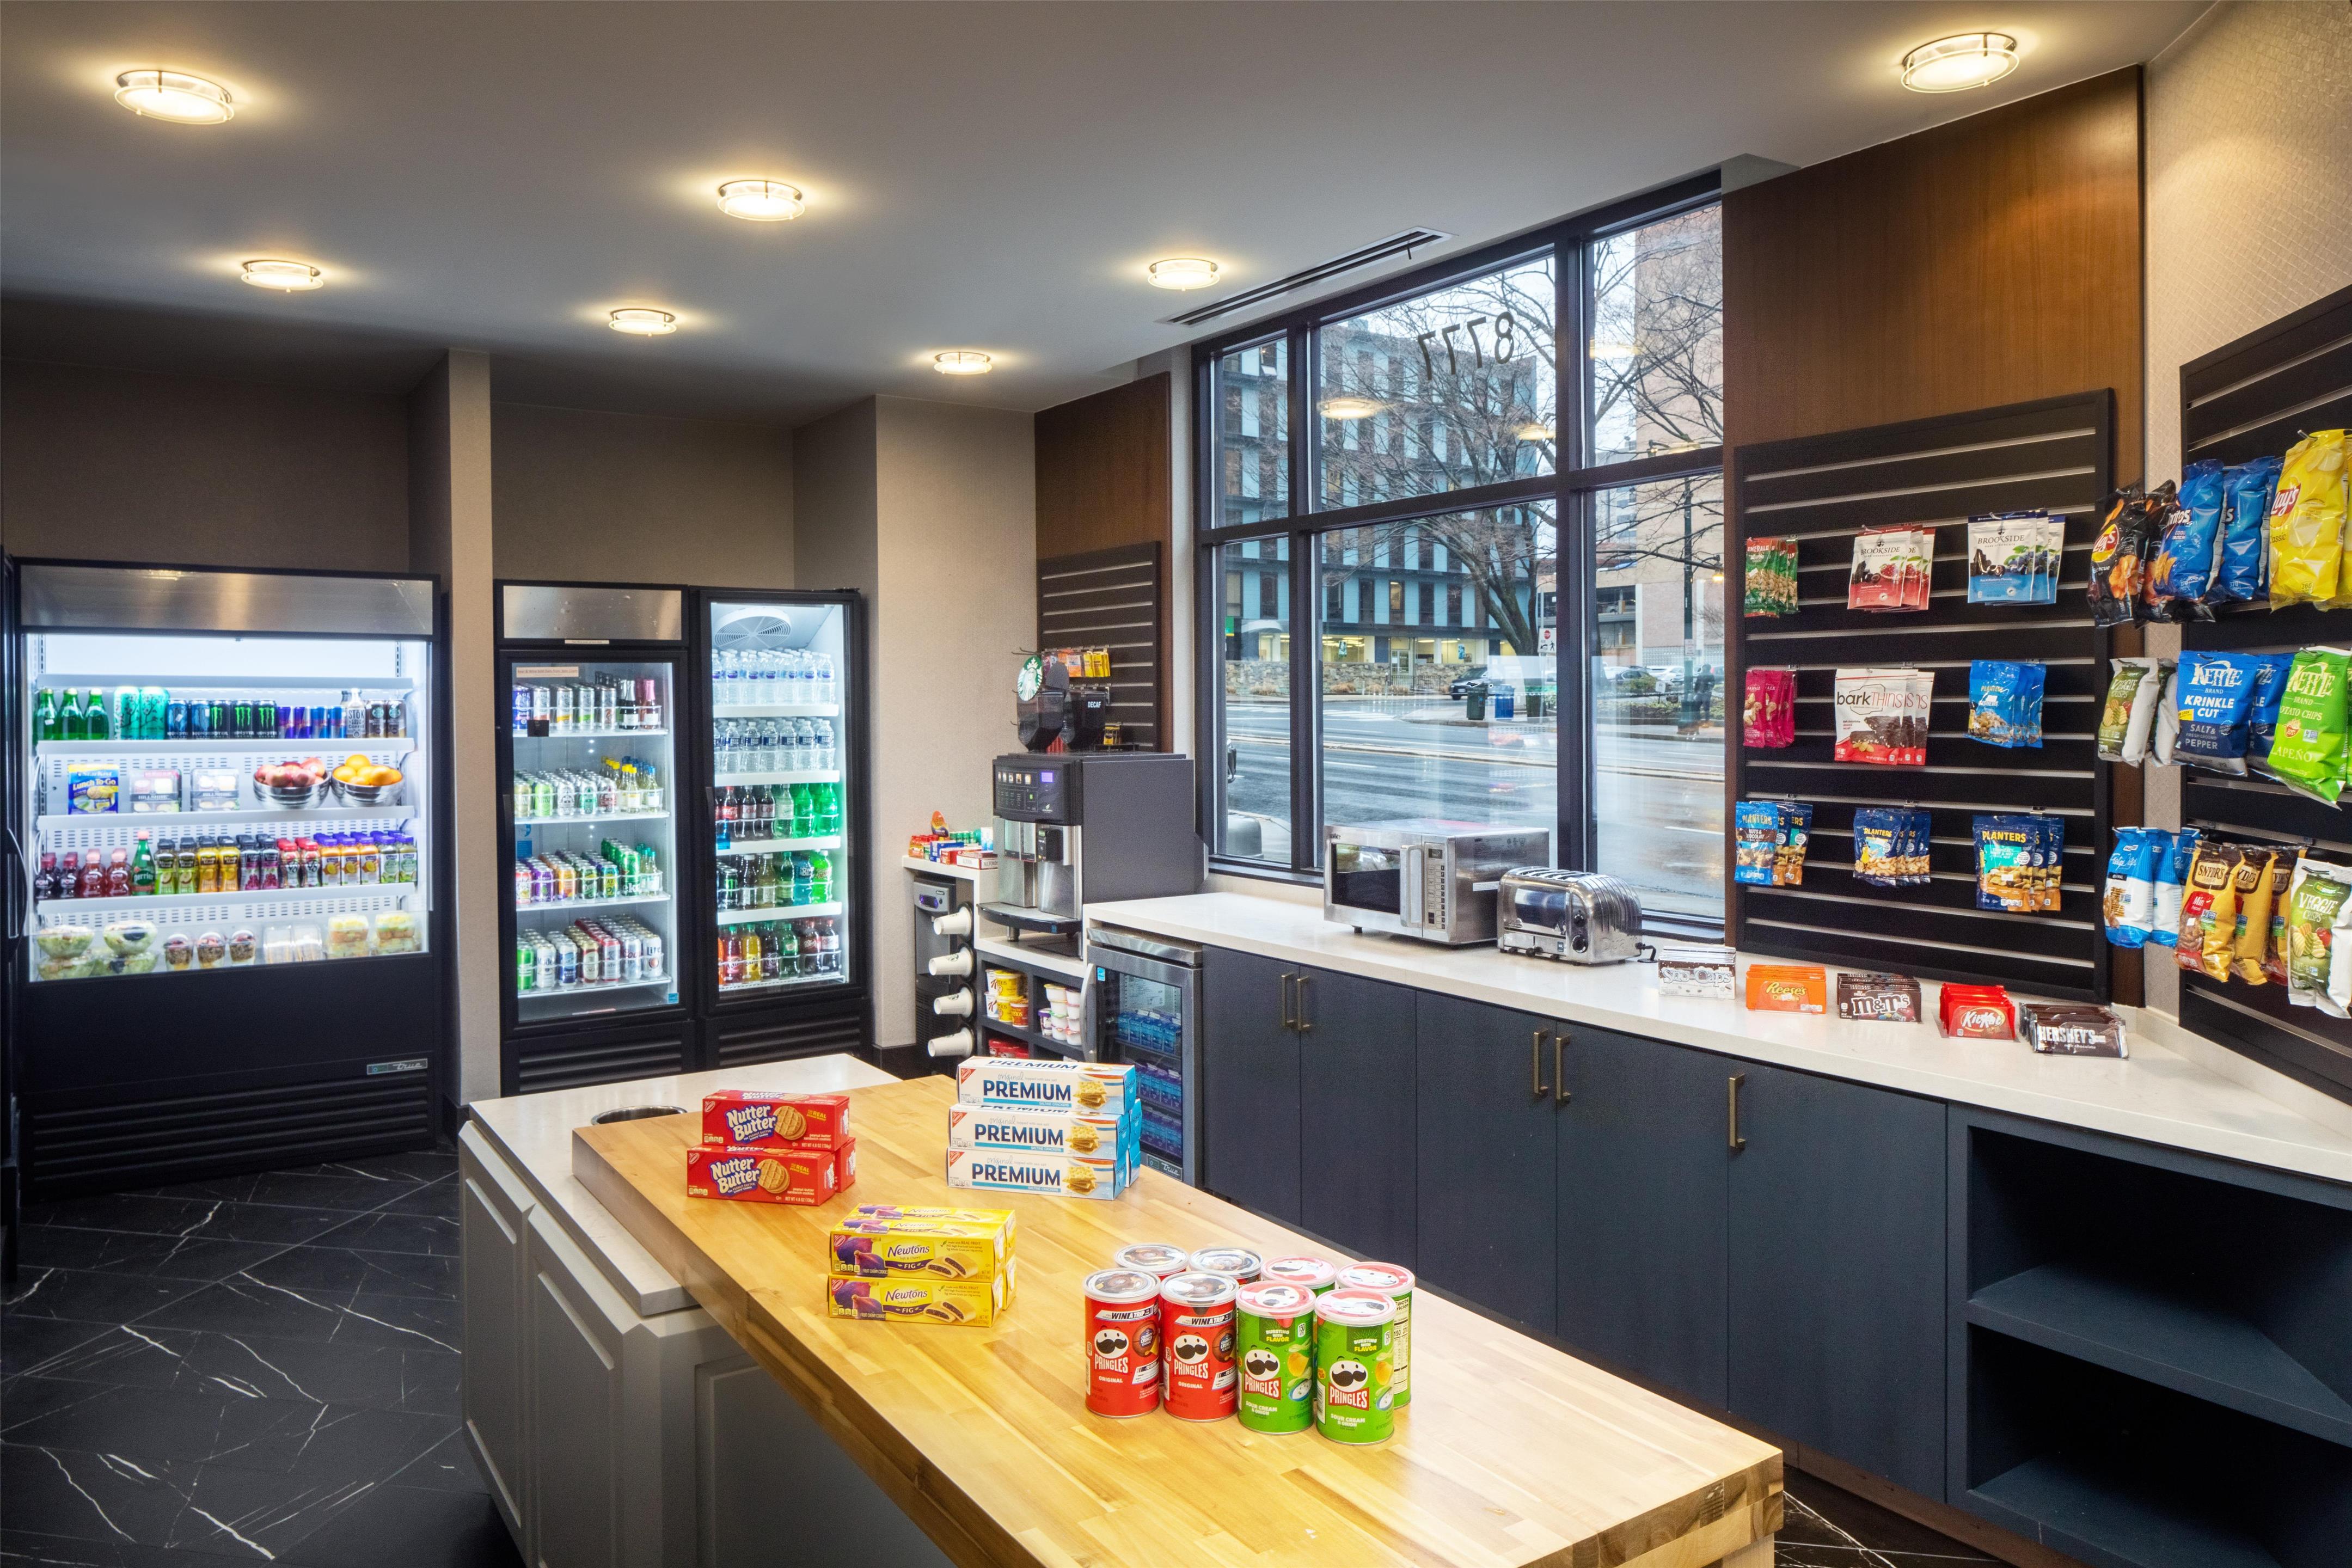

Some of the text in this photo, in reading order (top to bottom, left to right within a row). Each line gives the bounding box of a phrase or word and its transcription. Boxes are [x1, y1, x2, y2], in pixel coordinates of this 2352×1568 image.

[2271, 487, 2300, 517] Lay's
[1977, 534, 2025, 544] BROOKSIDE
[2092, 531, 2116, 553] Lay's
[1860, 546, 1900, 555] BROOKSIDE
[2189, 660, 2243, 688] KETTLE
[2286, 661, 2336, 697] KETTLE
[2184, 695, 2234, 708] KRINKLE
[2294, 697, 2313, 705] BRAND
[2197, 708, 2219, 718] CUT
[2301, 709, 2323, 720] CHIPS
[2190, 724, 2210, 733] SALT
[2185, 739, 2218, 750] PEPPER
[1742, 814, 1772, 825] PLANTERS
[1864, 828, 1892, 837] PLANTERS
[1982, 830, 2026, 843] PLANTERS
[2298, 892, 2339, 915] VEGGIE
[2302, 911, 2323, 922] CRISPS
[647, 946, 661, 956] Lite
[1662, 966, 1732, 988] Sno-Caps
[1766, 982, 1808, 996] Reese's
[1851, 994, 1910, 1016] m&m's
[2038, 1026, 2096, 1044] HERSHEY'S
[987, 1059, 1080, 1069] PREMIUM
[997, 1071, 1024, 1087] original
[983, 1079, 1071, 1101] PREMIUM
[726, 1105, 771, 1128] Nutter
[989, 1116, 1016, 1130] original
[733, 1117, 777, 1141] Butter
[975, 1123, 1063, 1146] PREMIUM
[710, 1159, 754, 1180] Nutter
[795, 1164, 810, 1173] REAL
[987, 1155, 1013, 1170] original
[1161, 1162, 1180, 1177] True
[718, 1169, 759, 1194] Butter
[972, 1163, 1061, 1186] PREMIUM
[887, 1244, 930, 1258] Newtons
[885, 1288, 928, 1302] Newtons
[1094, 1353, 1129, 1374] PRINGLES
[1174, 1359, 1209, 1379] PRINGLES
[1245, 1376, 1279, 1398] PRINGLES
[1330, 1386, 1367, 1408] PRINGLES
